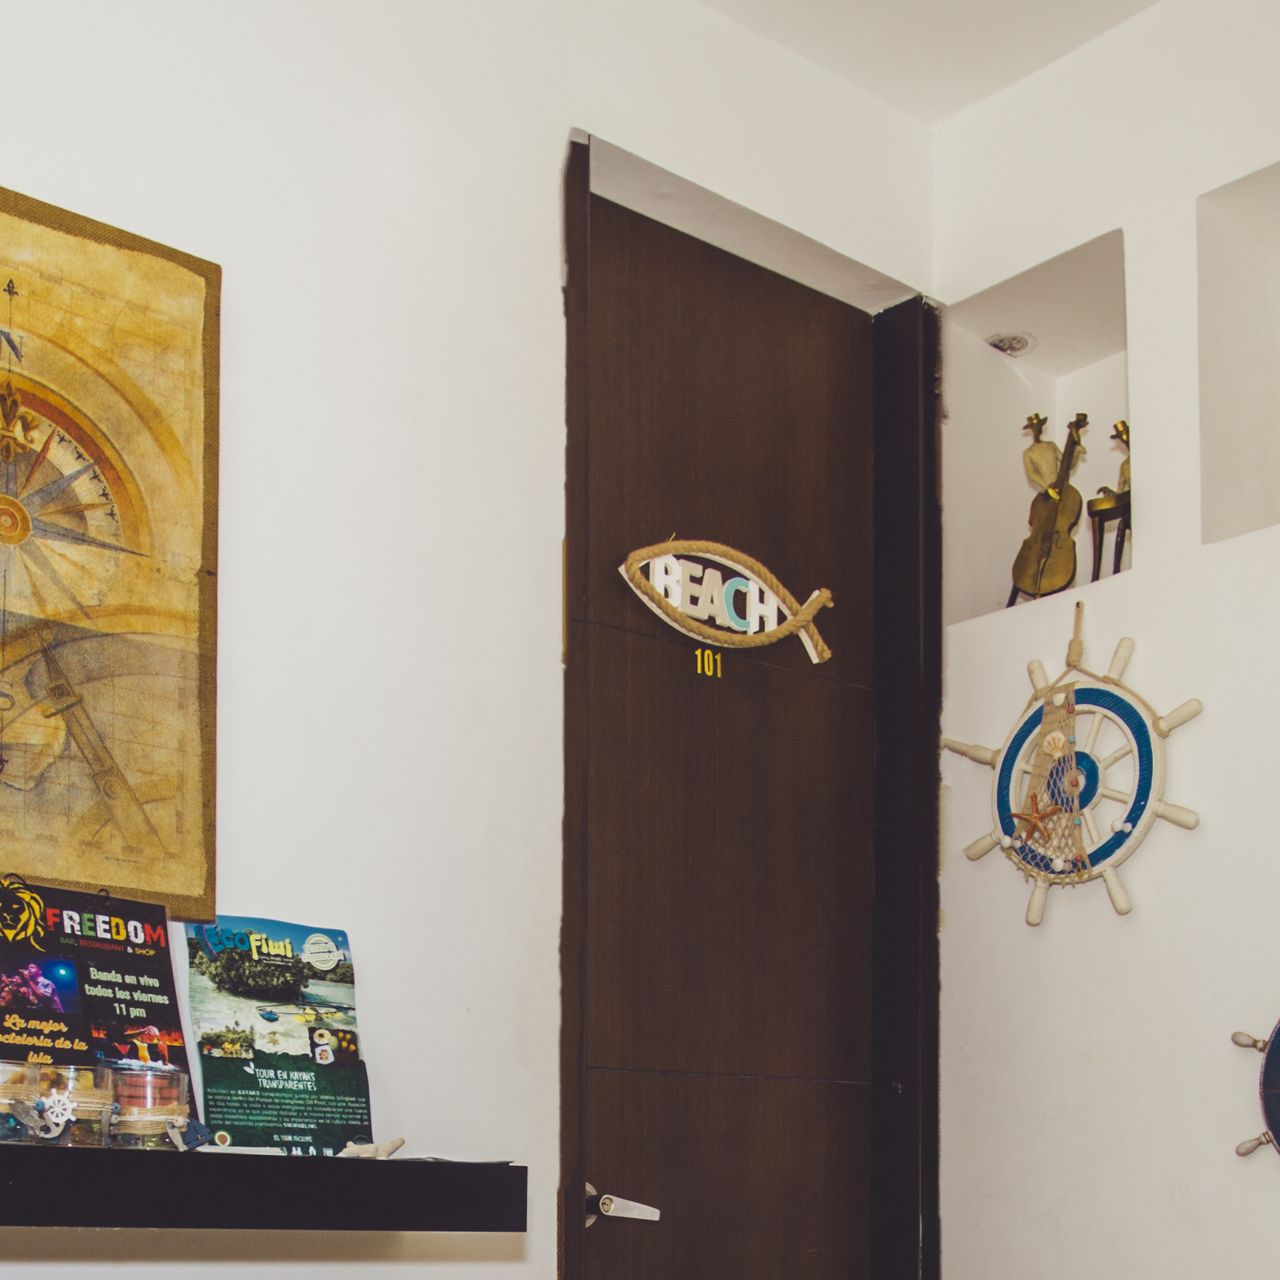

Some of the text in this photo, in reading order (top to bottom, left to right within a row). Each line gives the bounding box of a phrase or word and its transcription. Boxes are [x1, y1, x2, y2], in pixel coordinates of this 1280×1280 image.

[650, 554, 778, 635] BEACH
[695, 648, 721, 678] 101
[45, 907, 166, 948] FREEDOM
[134, 947, 156, 957] SHOP
[89, 967, 160, 987] Banda en vivo
[84, 983, 170, 1004] todos los viernes
[114, 1003, 146, 1018] 11 pm
[3, 1014, 68, 1034] La mejor
[54, 1037, 72, 1049] de
[73, 1038, 88, 1051] la
[27, 1051, 53, 1064] isla
[255, 1069, 316, 1081] TOUR EN KAYAKS
[258, 1078, 317, 1092] TRANSPARENTES
